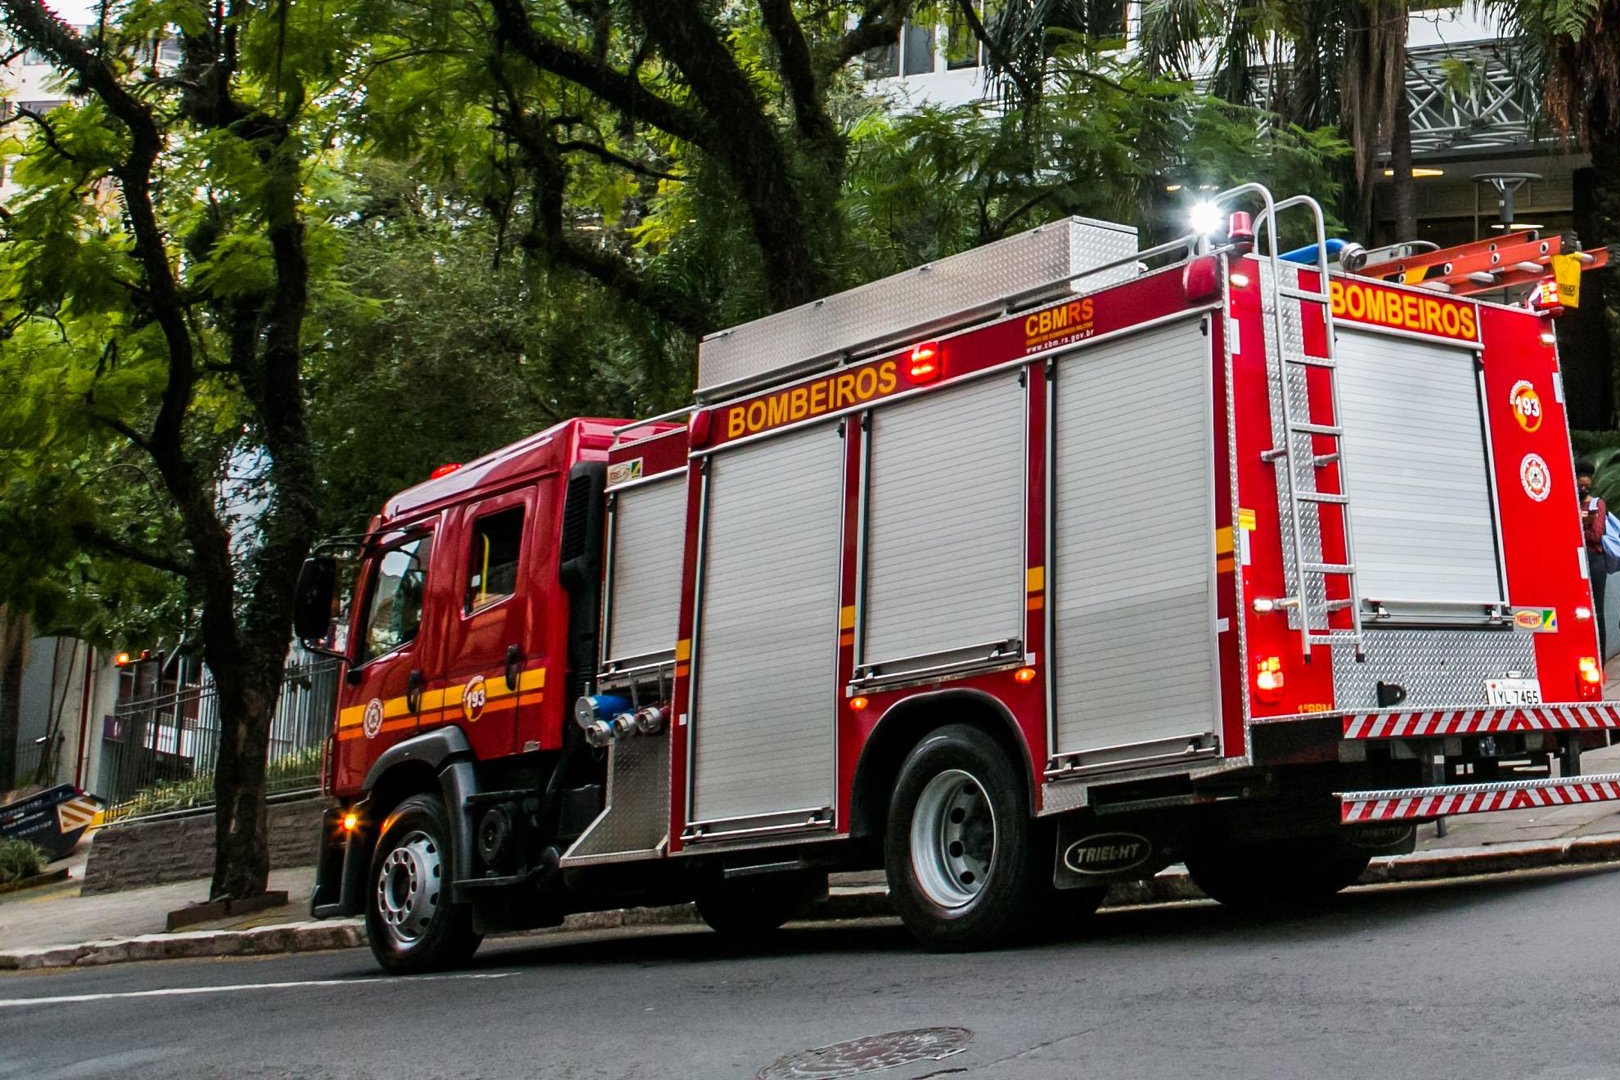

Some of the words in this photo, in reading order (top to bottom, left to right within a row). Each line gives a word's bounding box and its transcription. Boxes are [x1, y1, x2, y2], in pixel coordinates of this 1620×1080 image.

[1025, 298, 1094, 337] CBMRS
[1330, 281, 1476, 339] BOMBEIROS
[727, 361, 897, 438] BOMBEIROS
[1516, 395, 1540, 417] 193
[466, 689, 485, 713] 193
[1513, 690, 1539, 705] 7465
